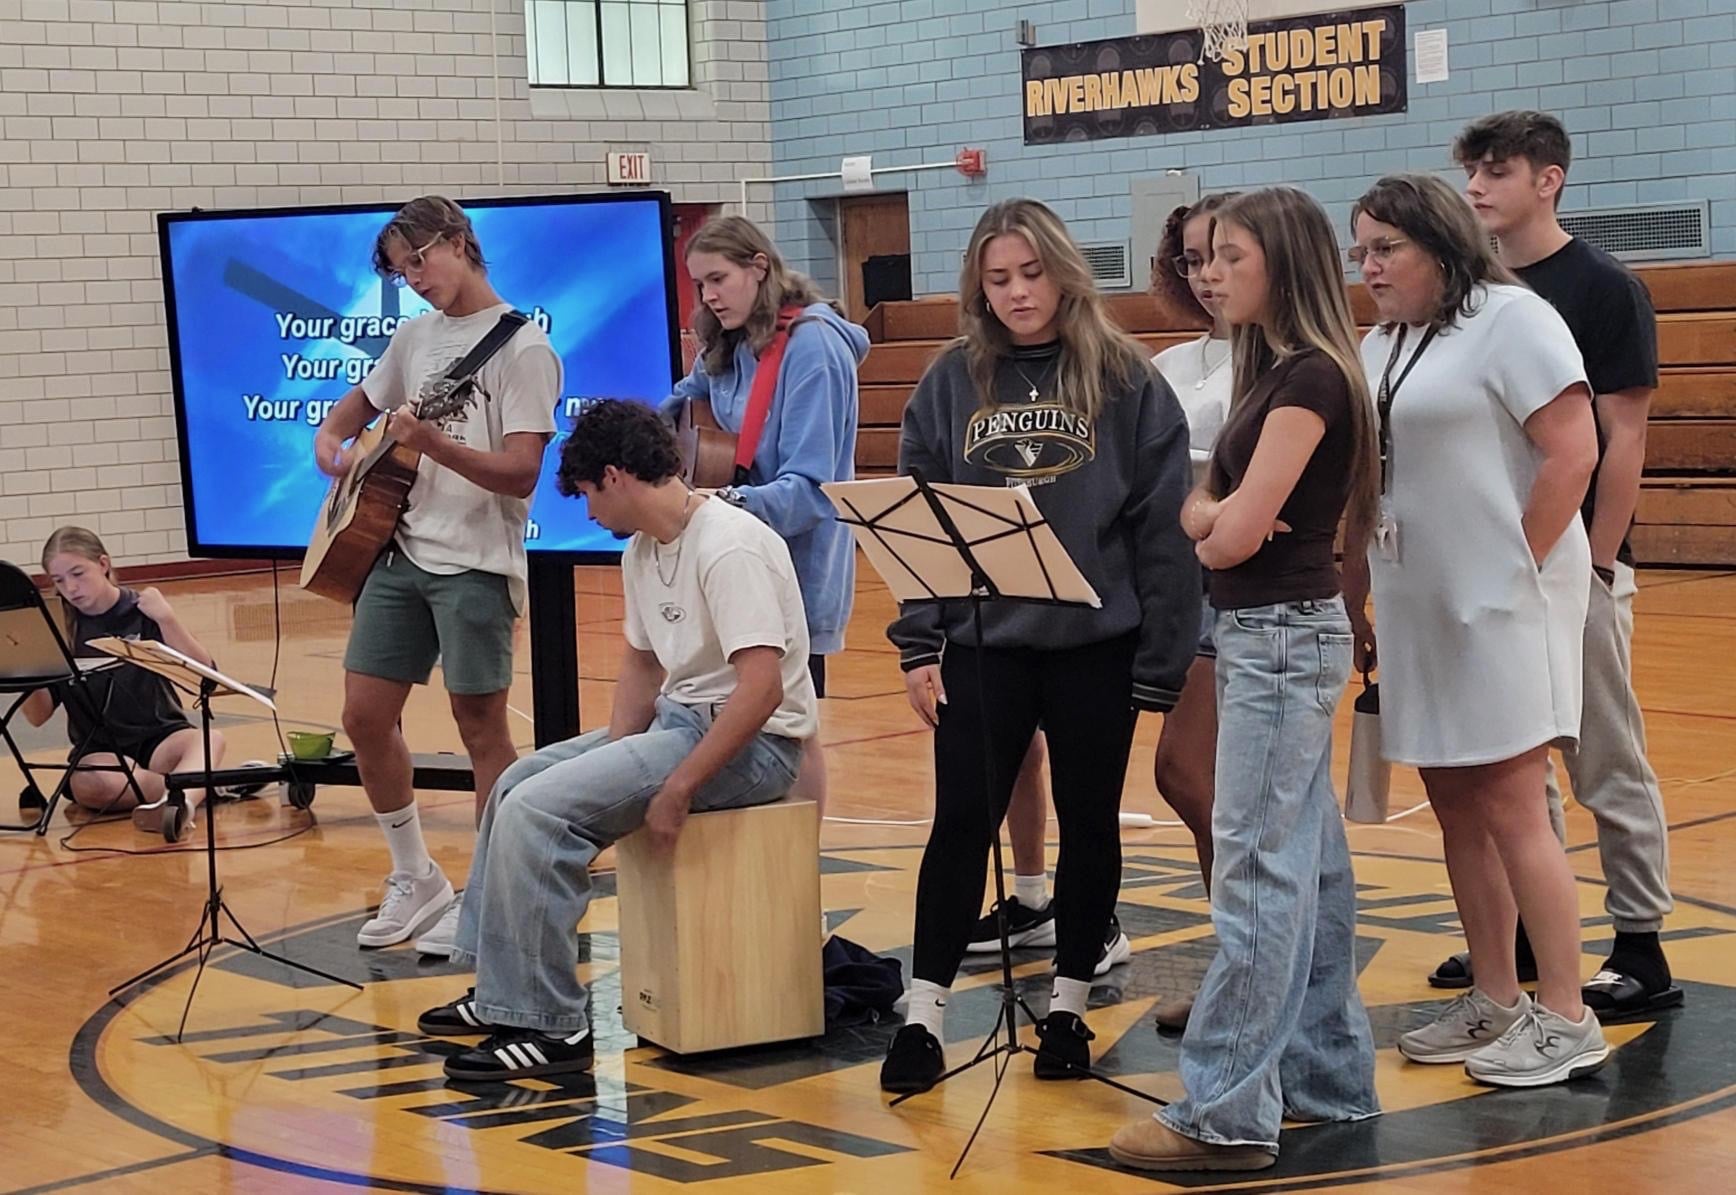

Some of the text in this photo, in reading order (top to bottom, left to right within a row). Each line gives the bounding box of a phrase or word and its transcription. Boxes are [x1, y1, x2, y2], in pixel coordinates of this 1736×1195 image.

[1221, 19, 1387, 77] STUDENT
[1026, 62, 1200, 117] RIVERHAWKS
[1227, 63, 1382, 119] SECTION
[619, 153, 646, 180] EXIT
[275, 312, 411, 343] Your grac
[281, 353, 340, 379] Your
[242, 394, 300, 420] Your
[971, 408, 1090, 443] PENGUINS
